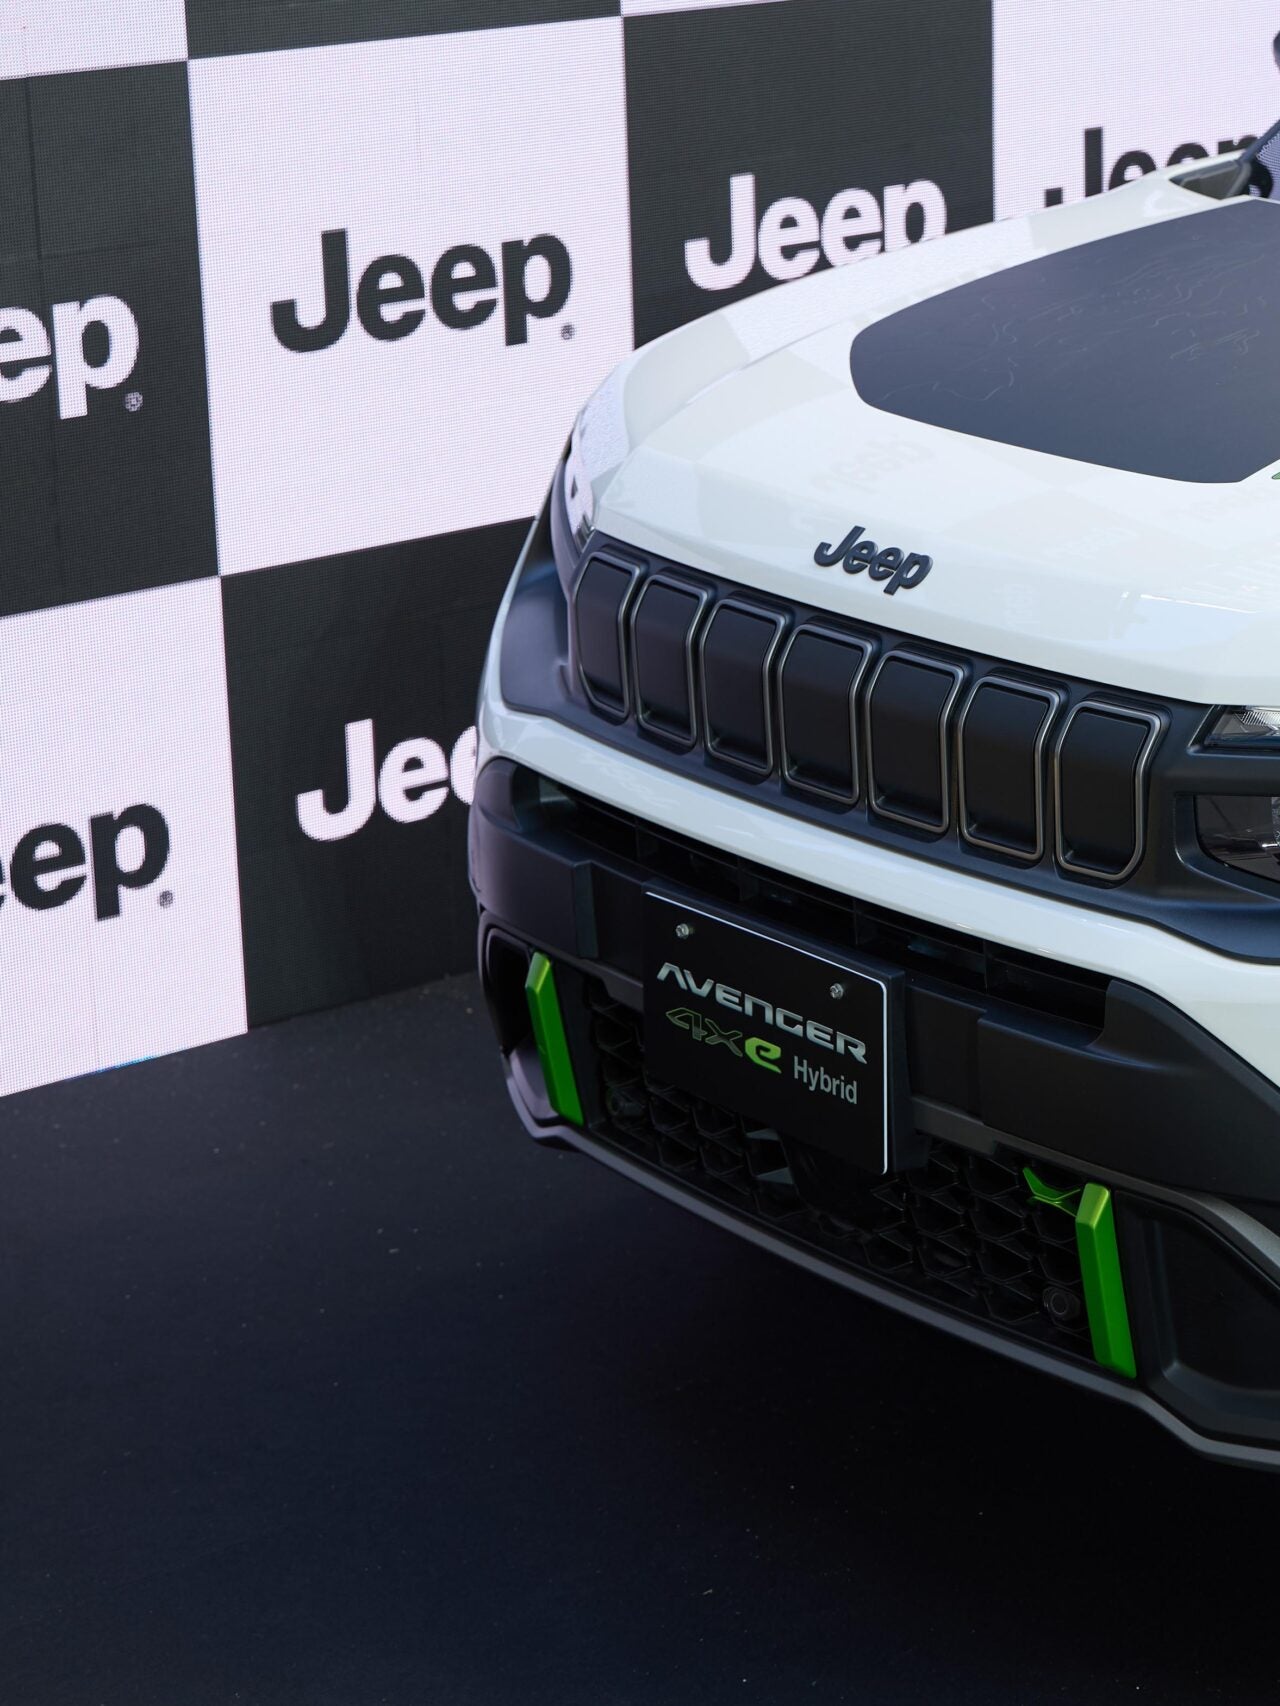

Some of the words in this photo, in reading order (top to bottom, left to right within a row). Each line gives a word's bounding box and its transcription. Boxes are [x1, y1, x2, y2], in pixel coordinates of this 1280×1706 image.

[270, 228, 572, 352] Jeep
[814, 525, 933, 596] Jeep
[656, 962, 867, 1064] AVENGER
[793, 1056, 858, 1105] Hybrid
